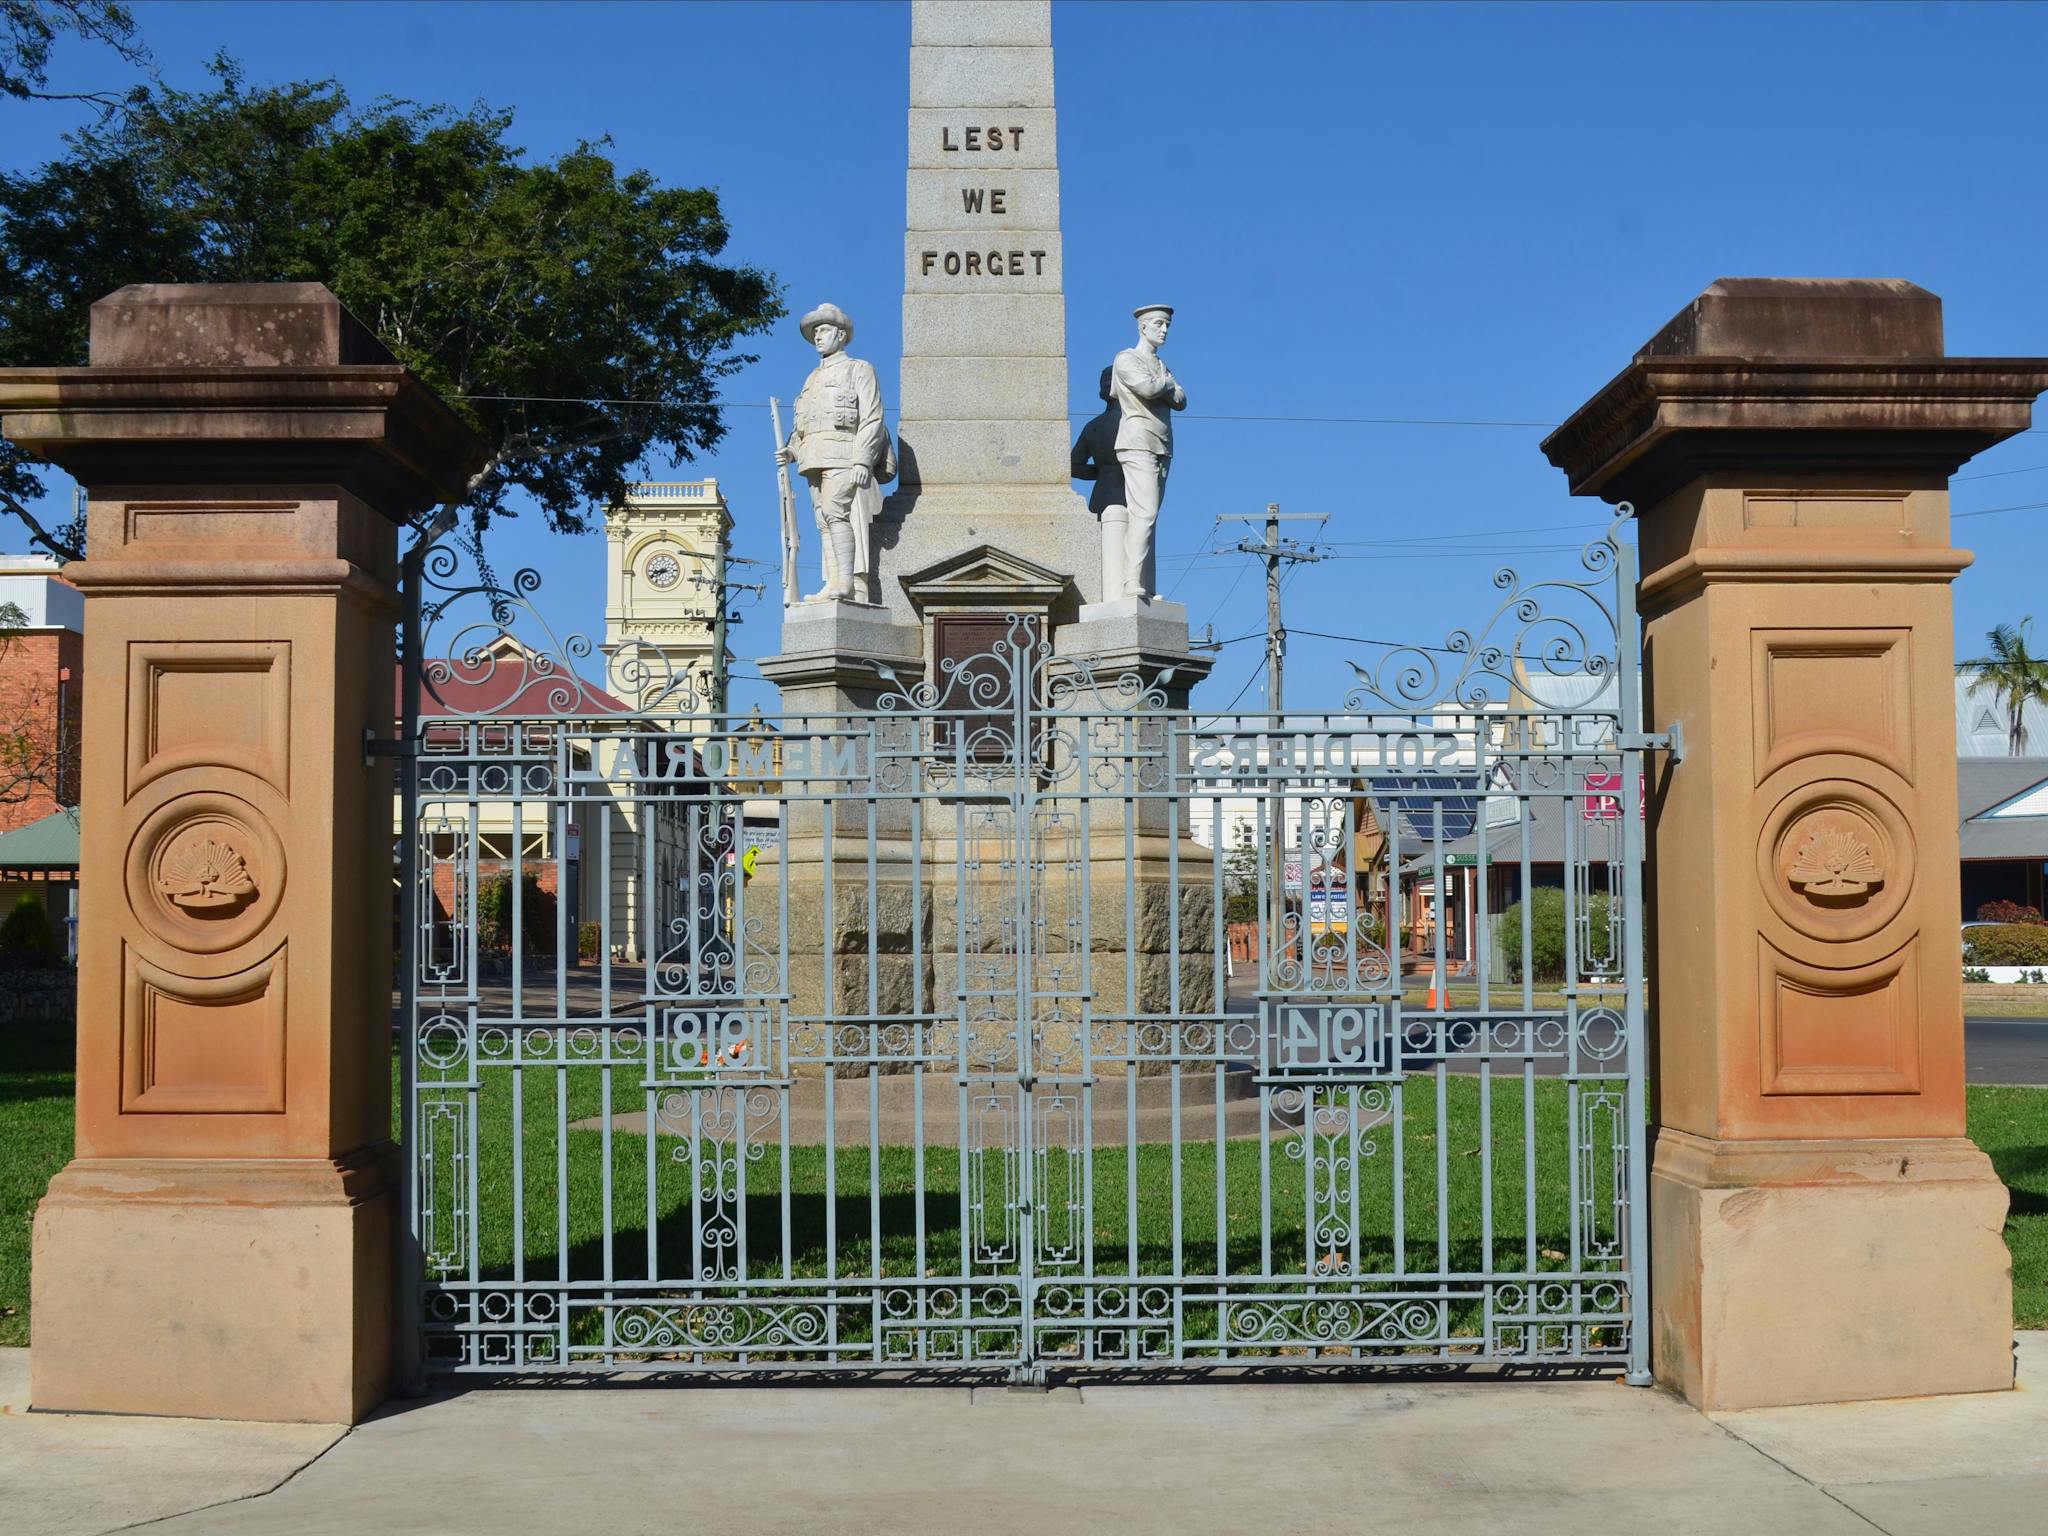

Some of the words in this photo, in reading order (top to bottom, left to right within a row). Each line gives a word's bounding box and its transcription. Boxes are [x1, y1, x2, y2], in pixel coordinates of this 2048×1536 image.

[943, 126, 1024, 151] LEST
[962, 188, 1006, 214] WE
[921, 250, 1046, 276] FORGET
